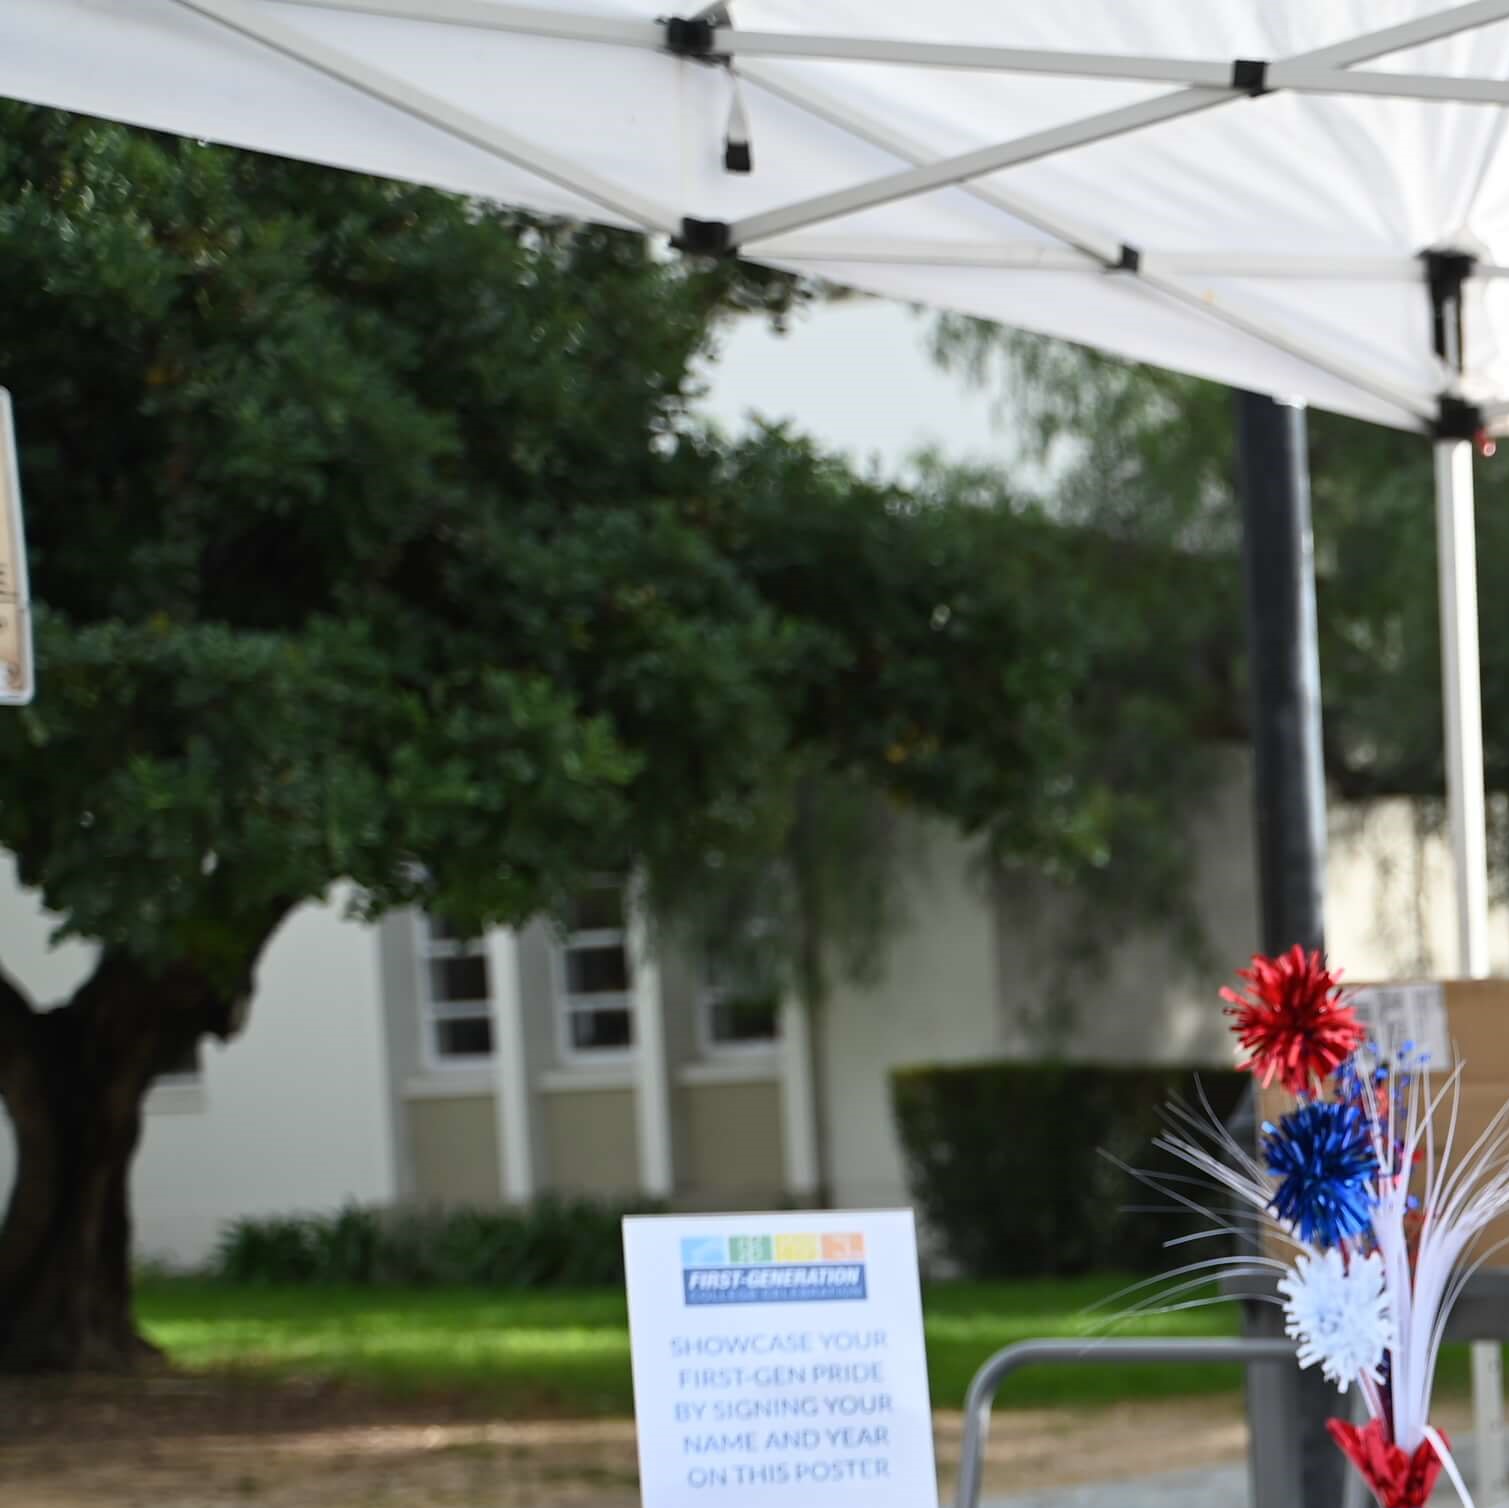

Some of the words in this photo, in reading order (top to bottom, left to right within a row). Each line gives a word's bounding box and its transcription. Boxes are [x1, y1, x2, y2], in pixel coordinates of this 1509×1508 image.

[669, 1331, 812, 1359] SHOWCASE
[818, 1329, 888, 1351] YOUR
[678, 1363, 806, 1388] FIRST-GEN
[812, 1361, 884, 1384] PRIDE
[675, 1402, 704, 1423] BY
[711, 1396, 819, 1420] SIGNING
[823, 1394, 893, 1417] YOUR
[684, 1432, 755, 1455] NAME
[765, 1429, 821, 1450] AND
[825, 1426, 889, 1448] YEAR
[686, 1466, 727, 1488] ON
[733, 1463, 790, 1486] THIS
[795, 1458, 891, 1483] POSTER
